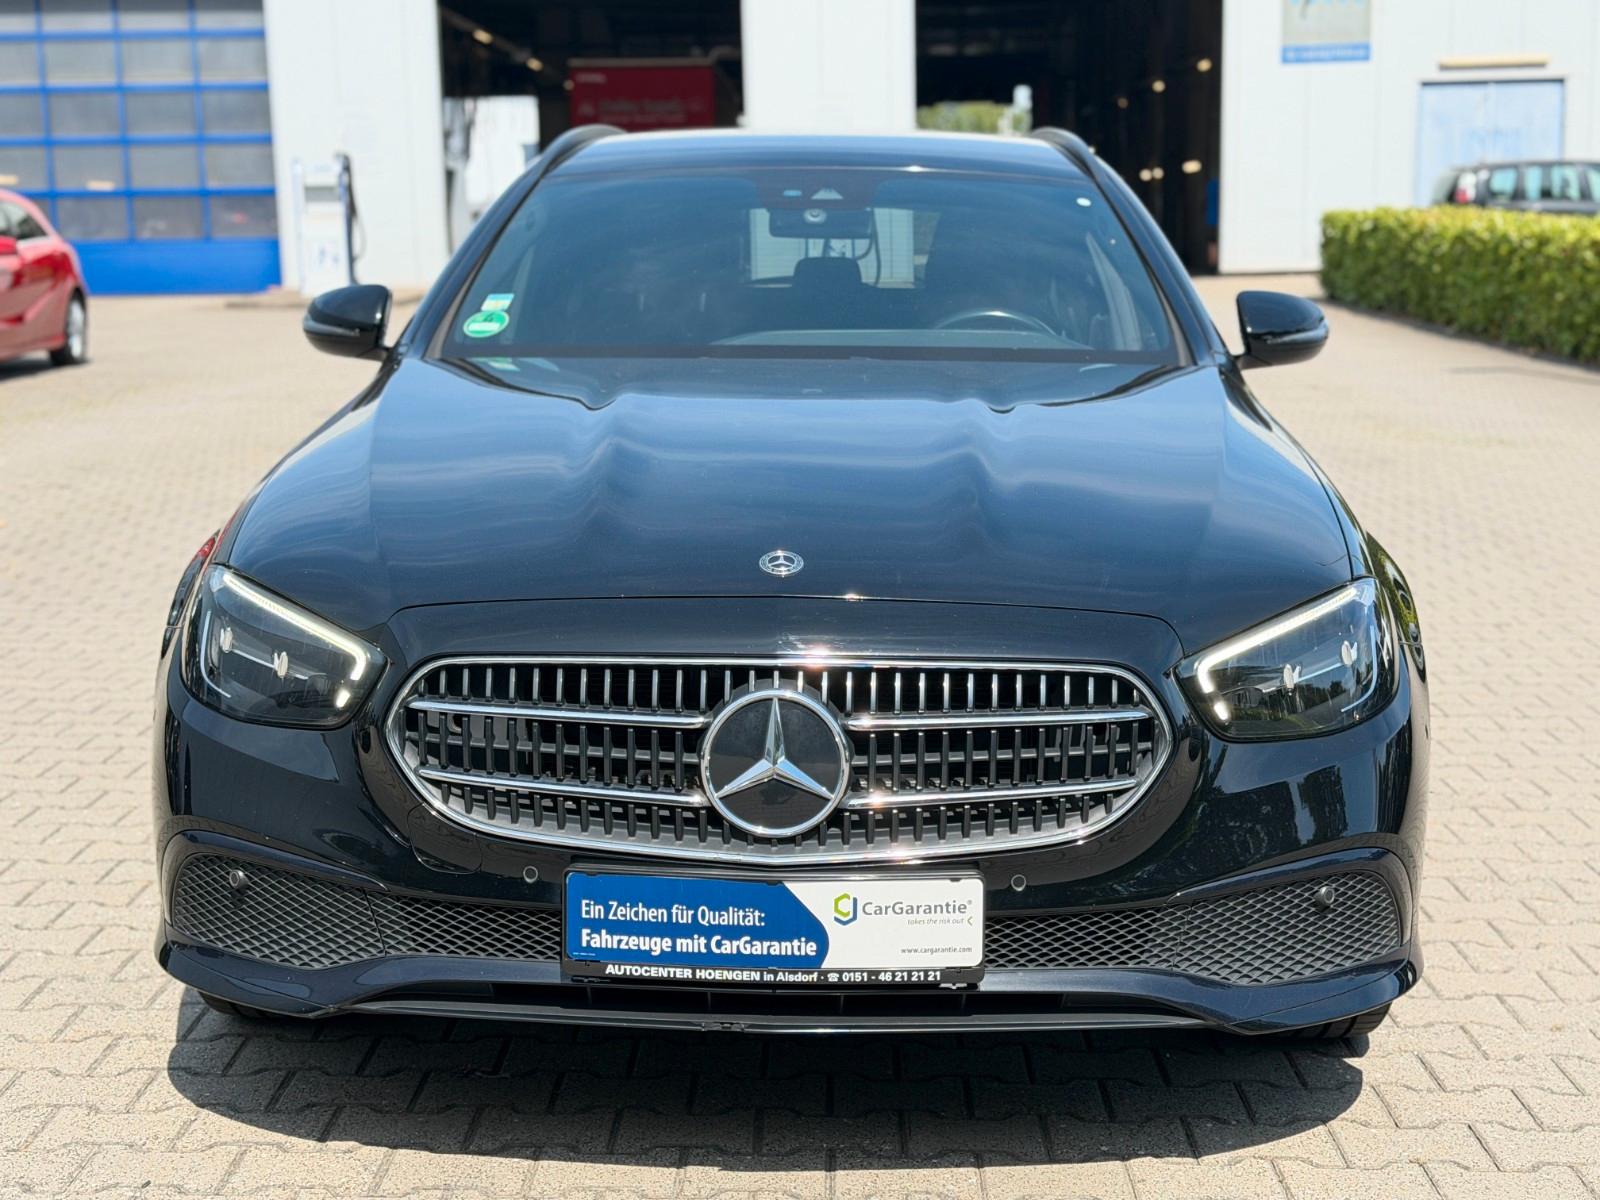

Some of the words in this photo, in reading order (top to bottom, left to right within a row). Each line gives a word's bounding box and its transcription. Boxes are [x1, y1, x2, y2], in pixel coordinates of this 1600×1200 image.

[581, 899, 605, 919] Ein
[608, 901, 668, 923] Zeichen
[671, 904, 695, 924] für
[697, 905, 766, 927] Qualität:
[907, 917, 925, 926] takes
[926, 917, 938, 926] the
[939, 917, 951, 925] risk
[952, 917, 965, 925] out
[581, 928, 672, 956] Fahrzeuge
[676, 934, 707, 954] mit
[710, 935, 817, 956] CarGarantie
[901, 946, 972, 955] www.cargarantie.com
[605, 964, 693, 979] AUTOCENTER
[695, 969, 761, 981] HOENGEN
[763, 971, 775, 981] in
[776, 971, 819, 982] Alsdorf
[842, 971, 868, 982] 0151
[878, 971, 892, 982] 46
[894, 971, 908, 981] 21
[911, 971, 925, 981] 21
[927, 971, 941, 981] 21
